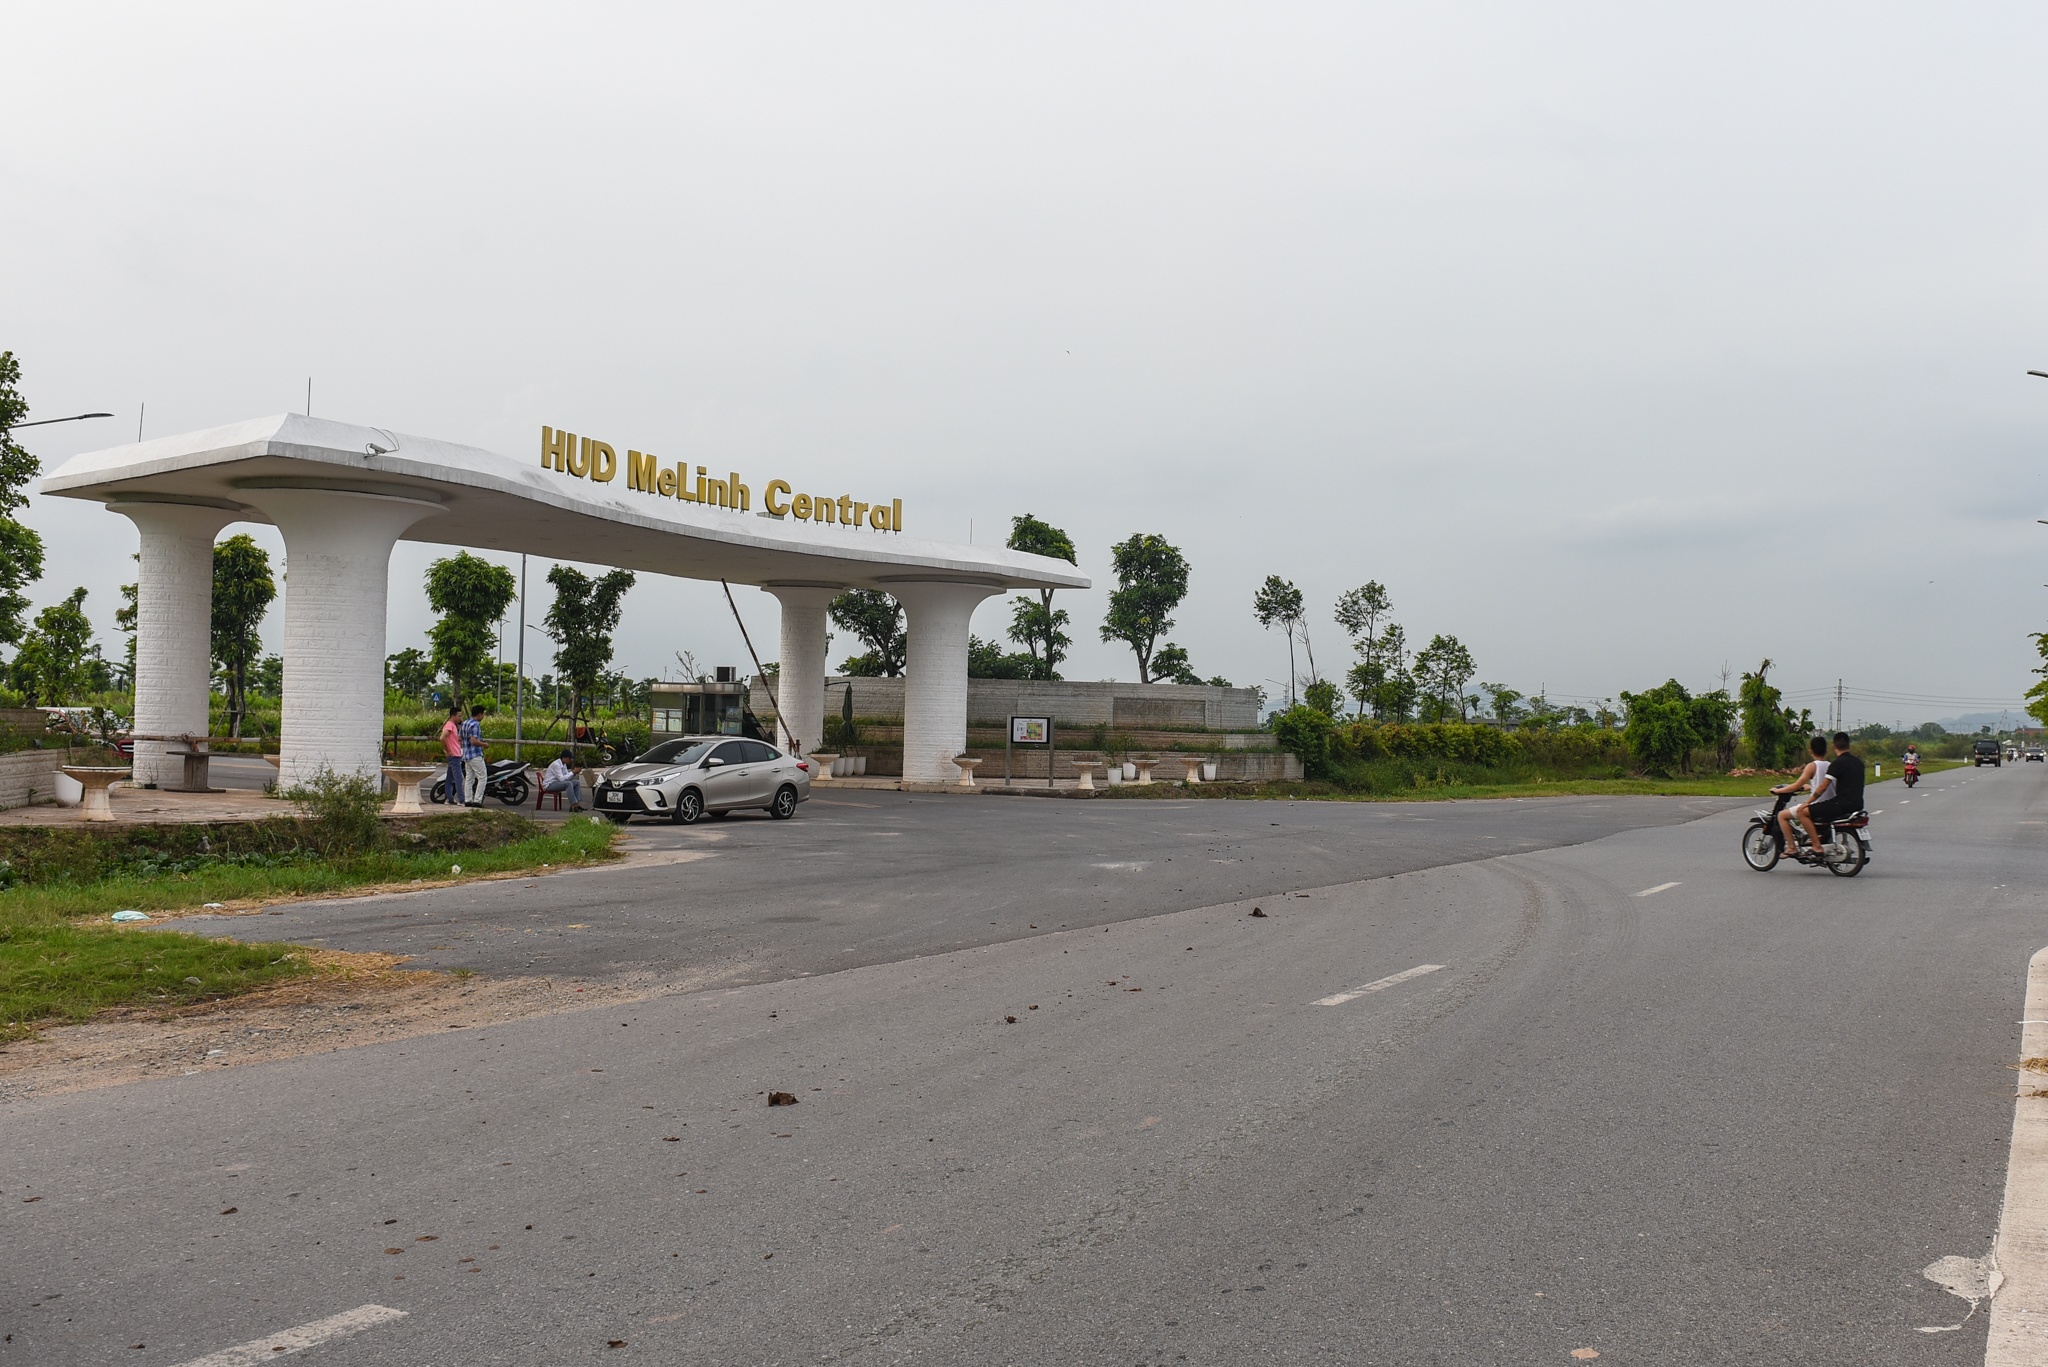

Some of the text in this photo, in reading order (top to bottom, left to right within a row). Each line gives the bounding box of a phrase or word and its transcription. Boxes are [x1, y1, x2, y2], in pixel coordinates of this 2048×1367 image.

[541, 425, 903, 532] HUD MeLinh Central
